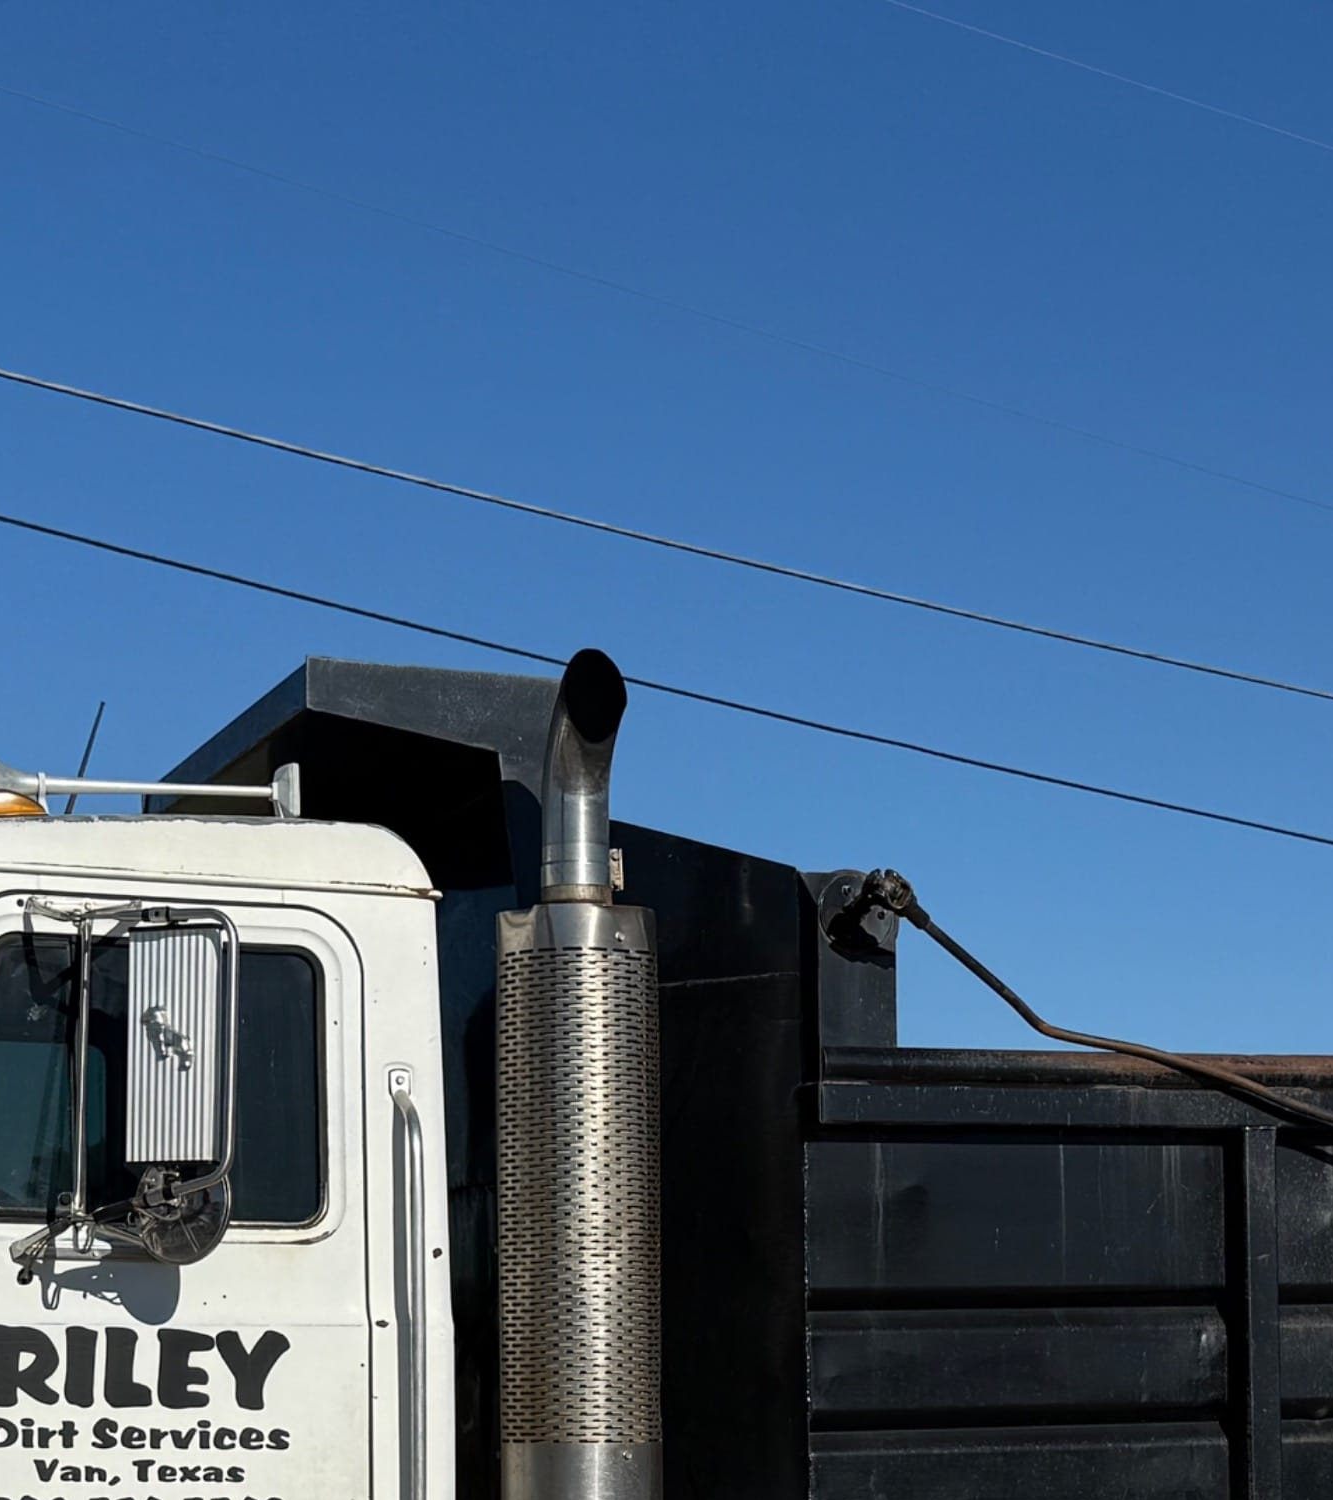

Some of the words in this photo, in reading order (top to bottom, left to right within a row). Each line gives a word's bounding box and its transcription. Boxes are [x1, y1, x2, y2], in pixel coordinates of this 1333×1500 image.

[92, 1418, 289, 1450] Services
[34, 1459, 120, 1486] Van,
[133, 1460, 244, 1482] Texas
